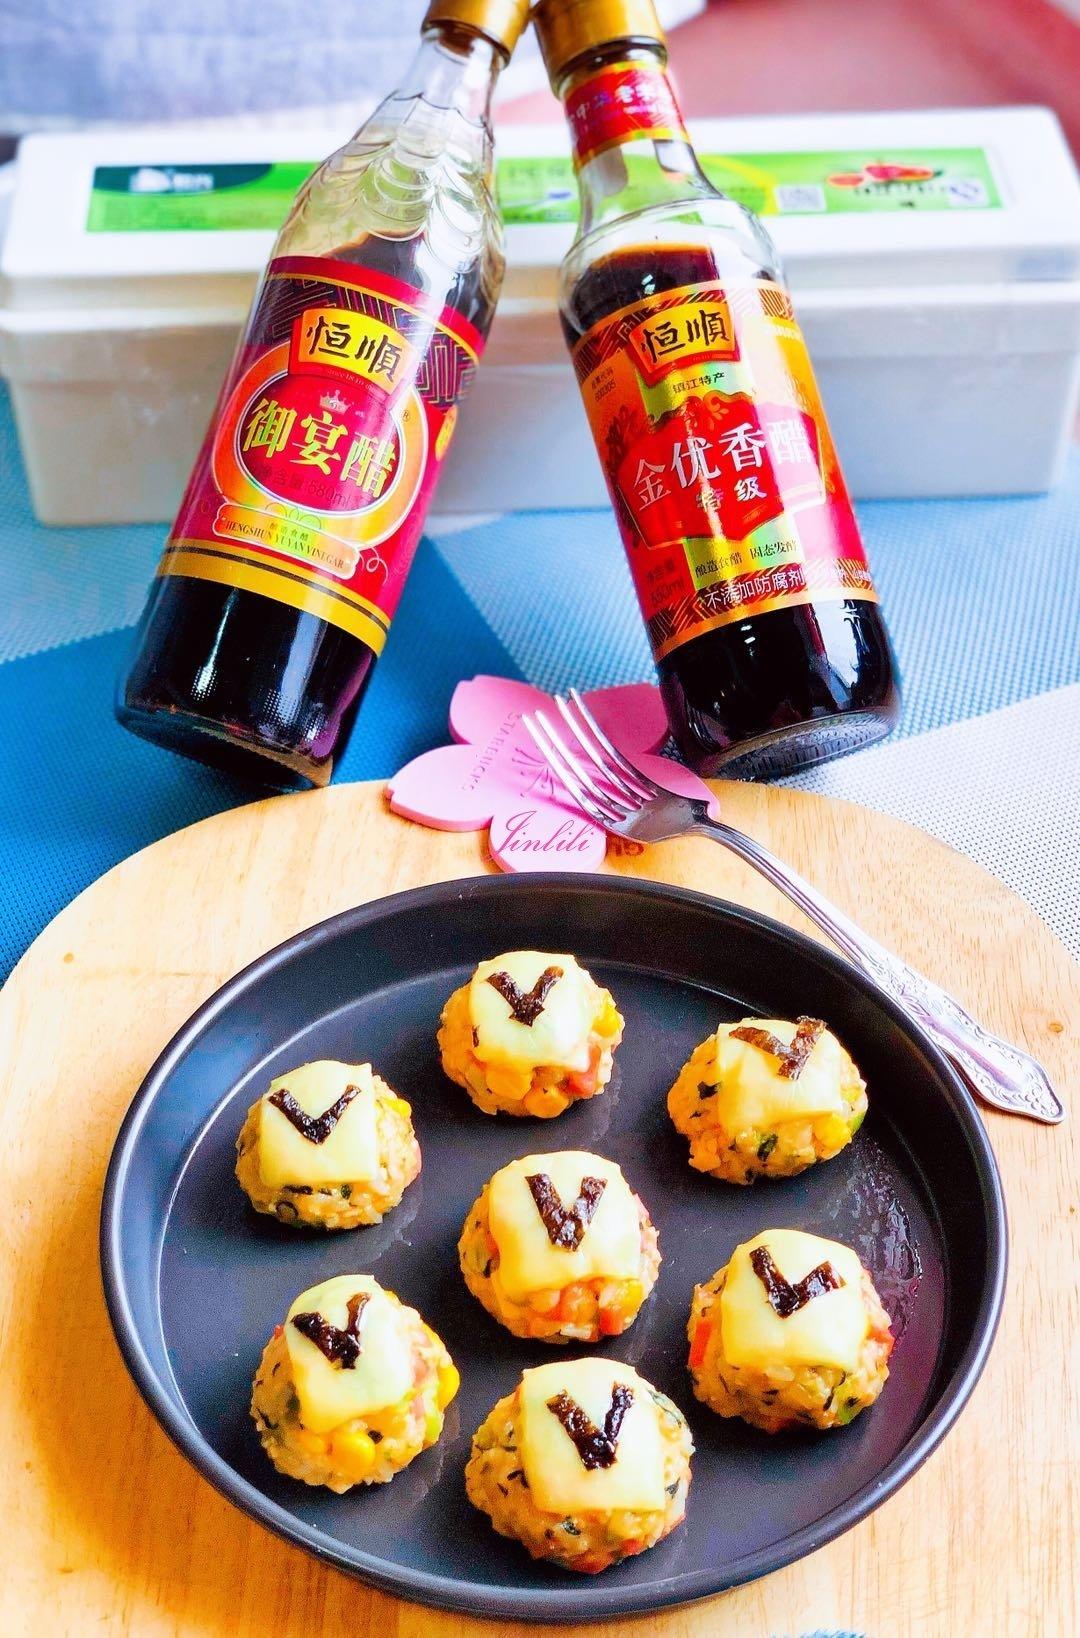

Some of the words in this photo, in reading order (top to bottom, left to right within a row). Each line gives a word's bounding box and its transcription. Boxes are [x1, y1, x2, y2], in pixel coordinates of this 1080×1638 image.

[673, 371, 725, 394] 镇江特产
[243, 398, 396, 498] 御宴醋
[633, 420, 811, 512] 金优香醋
[696, 476, 768, 512] 特级
[225, 519, 273, 540] HENGSHUN
[306, 545, 344, 569] VINEGAR
[694, 556, 743, 578] 酿造食醋
[706, 567, 806, 611] 不添加防腐剂
